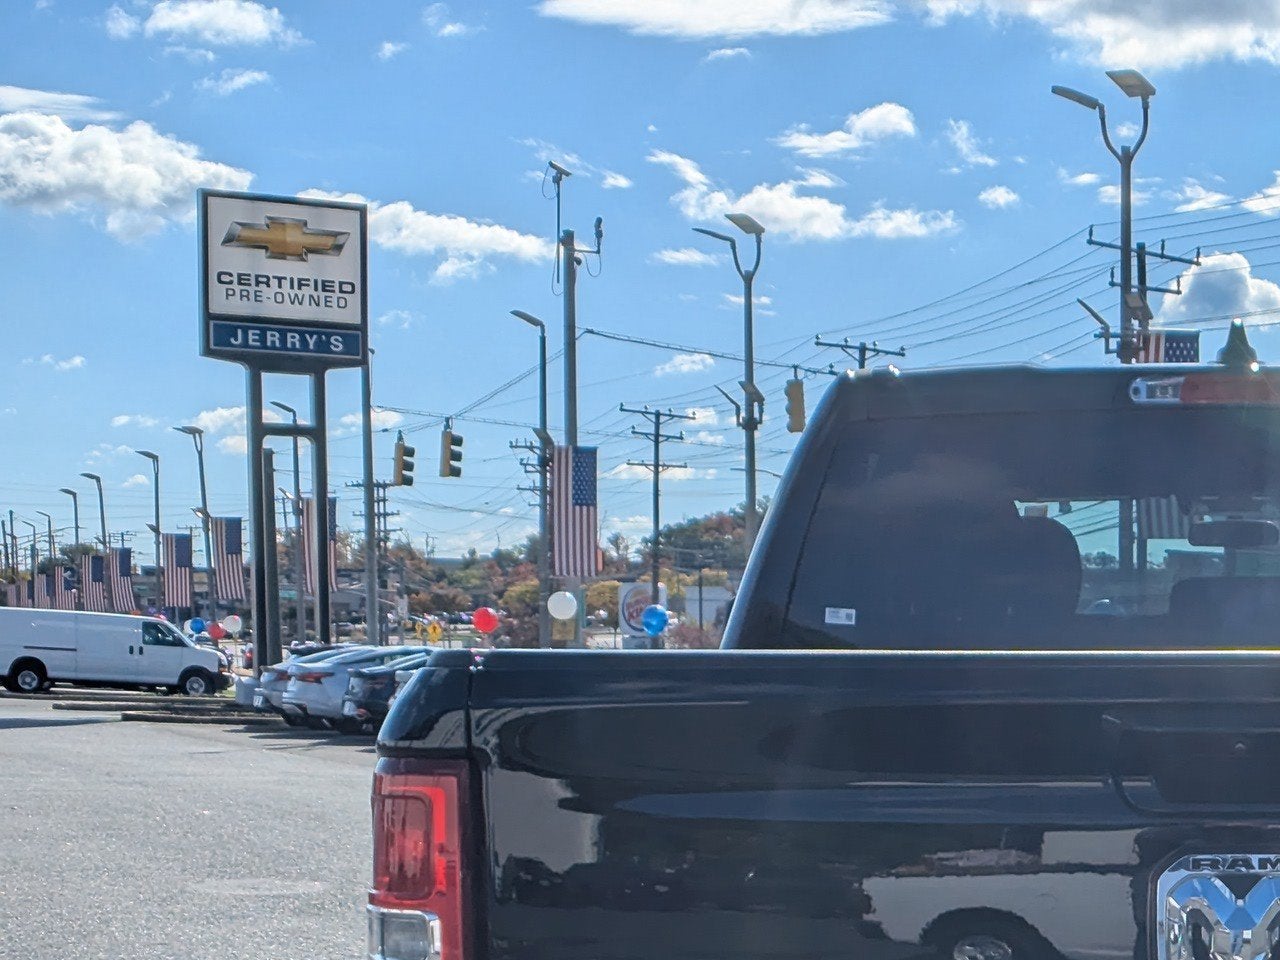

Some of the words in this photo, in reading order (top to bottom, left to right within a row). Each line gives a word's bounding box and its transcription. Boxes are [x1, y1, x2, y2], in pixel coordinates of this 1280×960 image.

[216, 271, 356, 295] CERTIFIED
[225, 288, 348, 309] PRE-OWNED
[230, 328, 344, 352] JERRY'S
